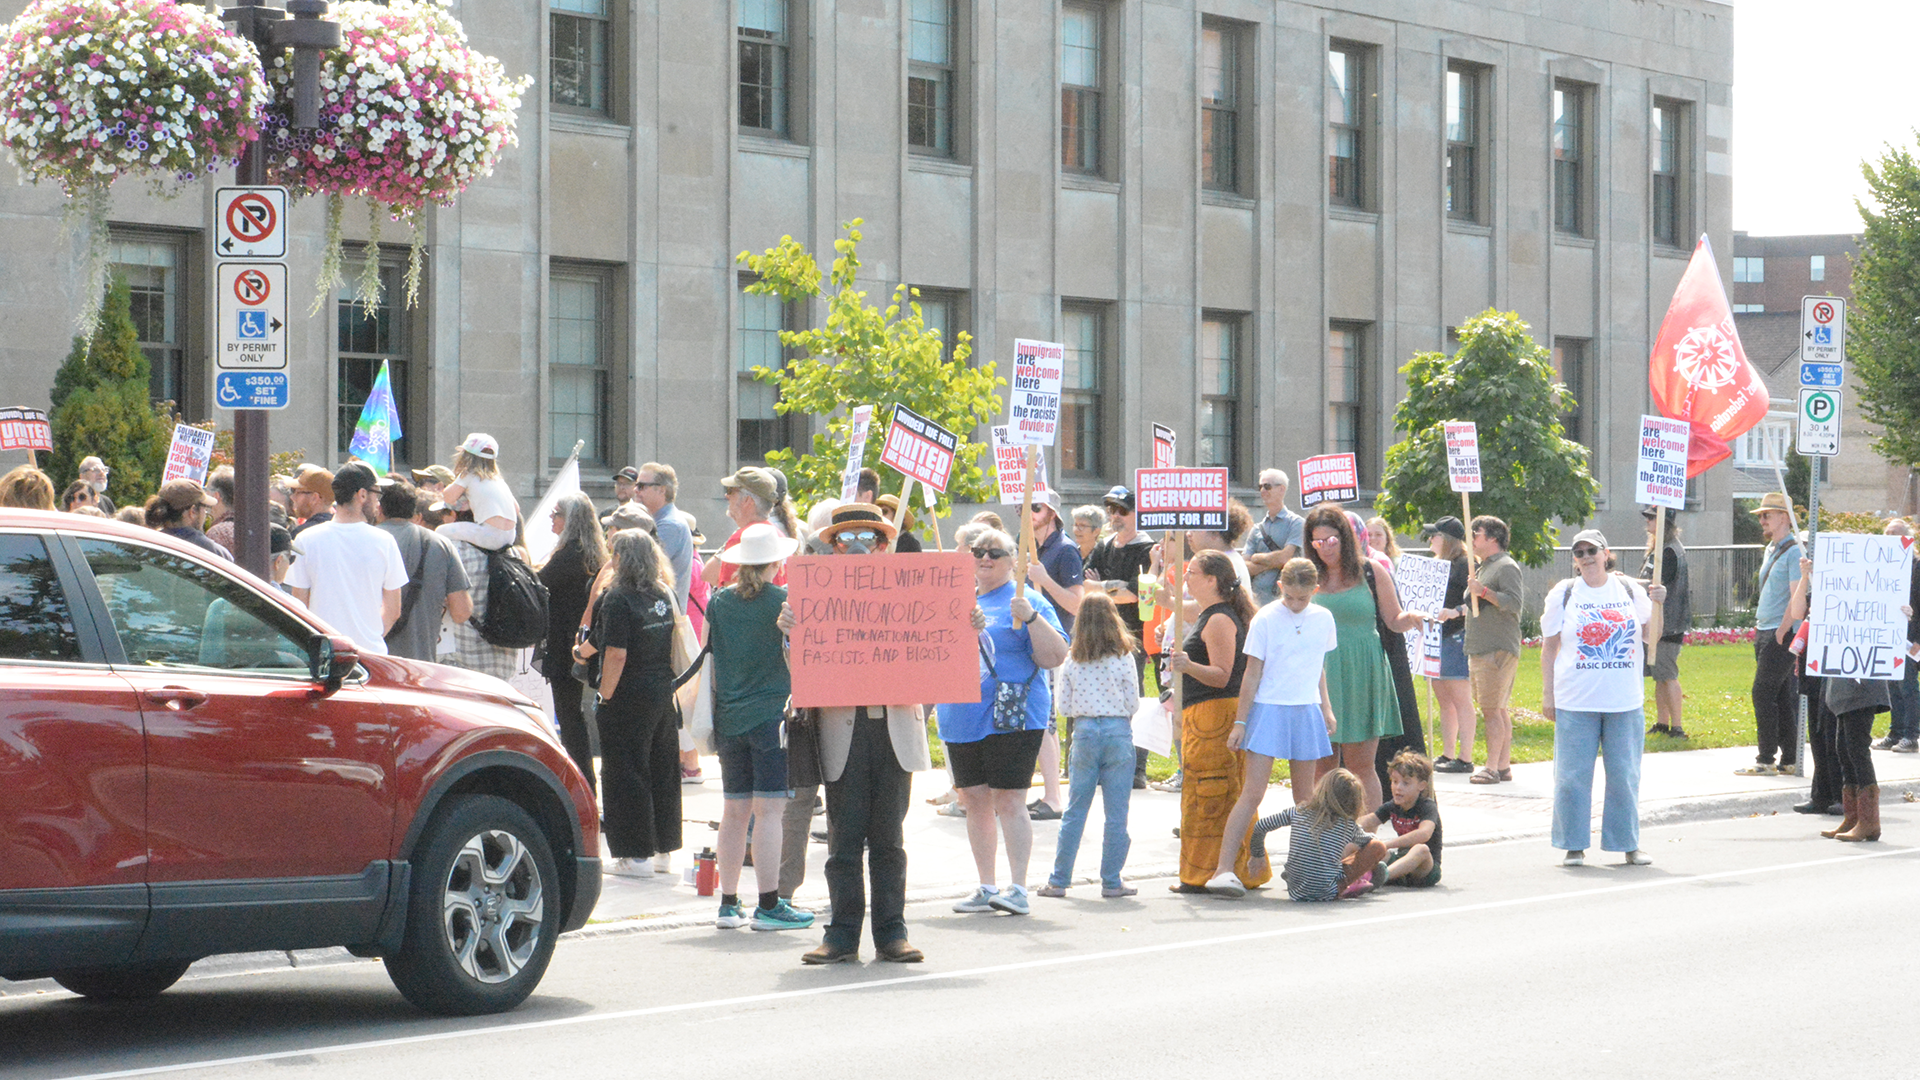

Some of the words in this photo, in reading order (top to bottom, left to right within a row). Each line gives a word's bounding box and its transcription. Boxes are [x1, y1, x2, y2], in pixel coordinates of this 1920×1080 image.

[227, 343, 239, 351] BY
[243, 343, 277, 352] PERMIT
[1018, 342, 1062, 360] Immigrants
[240, 354, 264, 362] ONLY
[1017, 353, 1035, 366] are
[1016, 364, 1060, 380] welcome
[1015, 374, 1040, 390] here
[255, 387, 276, 395] SET
[254, 397, 277, 405] FINE
[1027, 393, 1047, 408] Don't
[1047, 396, 1058, 408] let
[1814, 400, 1827, 415] P
[1013, 405, 1028, 418] the
[1030, 408, 1056, 420] racists
[1019, 418, 1044, 433] divide
[1045, 422, 1054, 433] us
[1643, 426, 1660, 438] are
[1644, 417, 1688, 435] Immigrants
[177, 426, 213, 441] SOLIDARITY
[924, 425, 939, 440] WE
[938, 432, 954, 449] FALL
[173, 441, 194, 456] fight
[191, 437, 207, 447] HATE
[1642, 437, 1685, 453] welcome
[890, 426, 949, 476] UNITED
[996, 446, 1023, 460] fight
[1642, 445, 1665, 459] here
[168, 463, 185, 474] and
[885, 448, 899, 463] WE
[898, 455, 915, 472] WIN
[915, 463, 932, 480] FOR
[931, 472, 945, 487] ALL
[1652, 461, 1673, 474] Don't
[1674, 464, 1685, 477] let
[1000, 470, 1021, 482] and
[1141, 473, 1223, 488] REGULARIZE
[1640, 471, 1655, 483] the
[1656, 474, 1684, 488] racists
[1001, 481, 1046, 494] fascm
[1324, 490, 1340, 500] FOR
[1340, 489, 1354, 499] ALL
[1647, 483, 1672, 497] divide
[1673, 488, 1683, 499] us
[1141, 490, 1223, 508] EVERYONE
[1141, 513, 1176, 526] STATUS
[1179, 513, 1200, 525] FOR
[1203, 513, 1222, 525] ALL
[1819, 536, 1856, 564] THE
[1863, 537, 1911, 570] ONLY
[796, 563, 833, 588] TO
[844, 565, 893, 590] HELL
[894, 568, 925, 588] WITH
[929, 566, 964, 589] THE
[1815, 569, 1859, 592] THING
[1864, 568, 1902, 594] MORE
[800, 597, 936, 626] DOMINIONOIDS
[949, 597, 961, 621] &
[803, 627, 827, 645] ALL
[1813, 624, 1849, 644] THAN
[1854, 627, 1887, 645] HATE
[1891, 628, 1904, 646] IS
[872, 647, 899, 663] AND
[906, 646, 950, 662] BIGOTS
[1821, 645, 1893, 677] LOVE
[1576, 662, 1600, 670] BASIC
